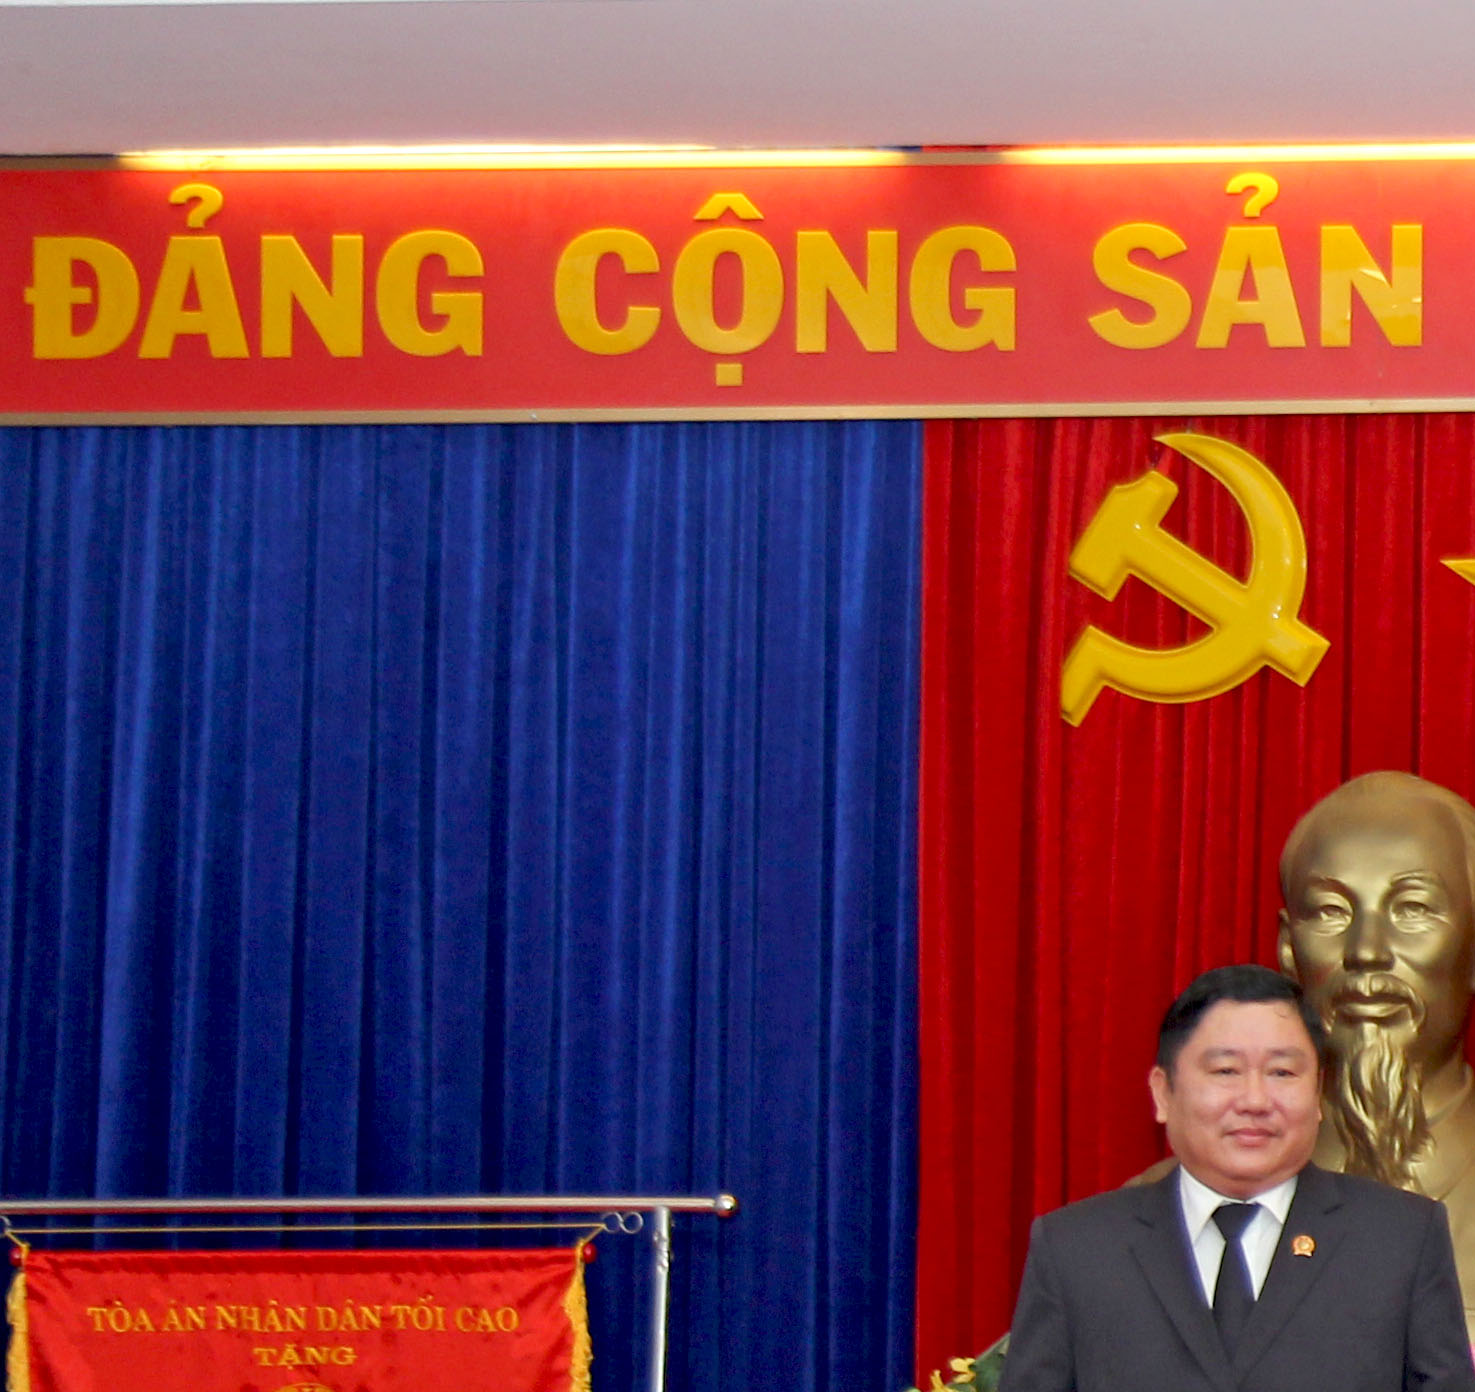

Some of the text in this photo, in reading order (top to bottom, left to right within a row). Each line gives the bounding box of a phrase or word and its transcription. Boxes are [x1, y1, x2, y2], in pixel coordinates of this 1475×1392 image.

[25, 182, 485, 359] ĐẢNG
[554, 192, 1017, 387] CỘNG
[1088, 171, 1424, 350] SẢN
[87, 1294, 520, 1333] TÒA ÁN NHÂN DÂN TỐI CAO
[252, 1343, 359, 1371] TẶNG
